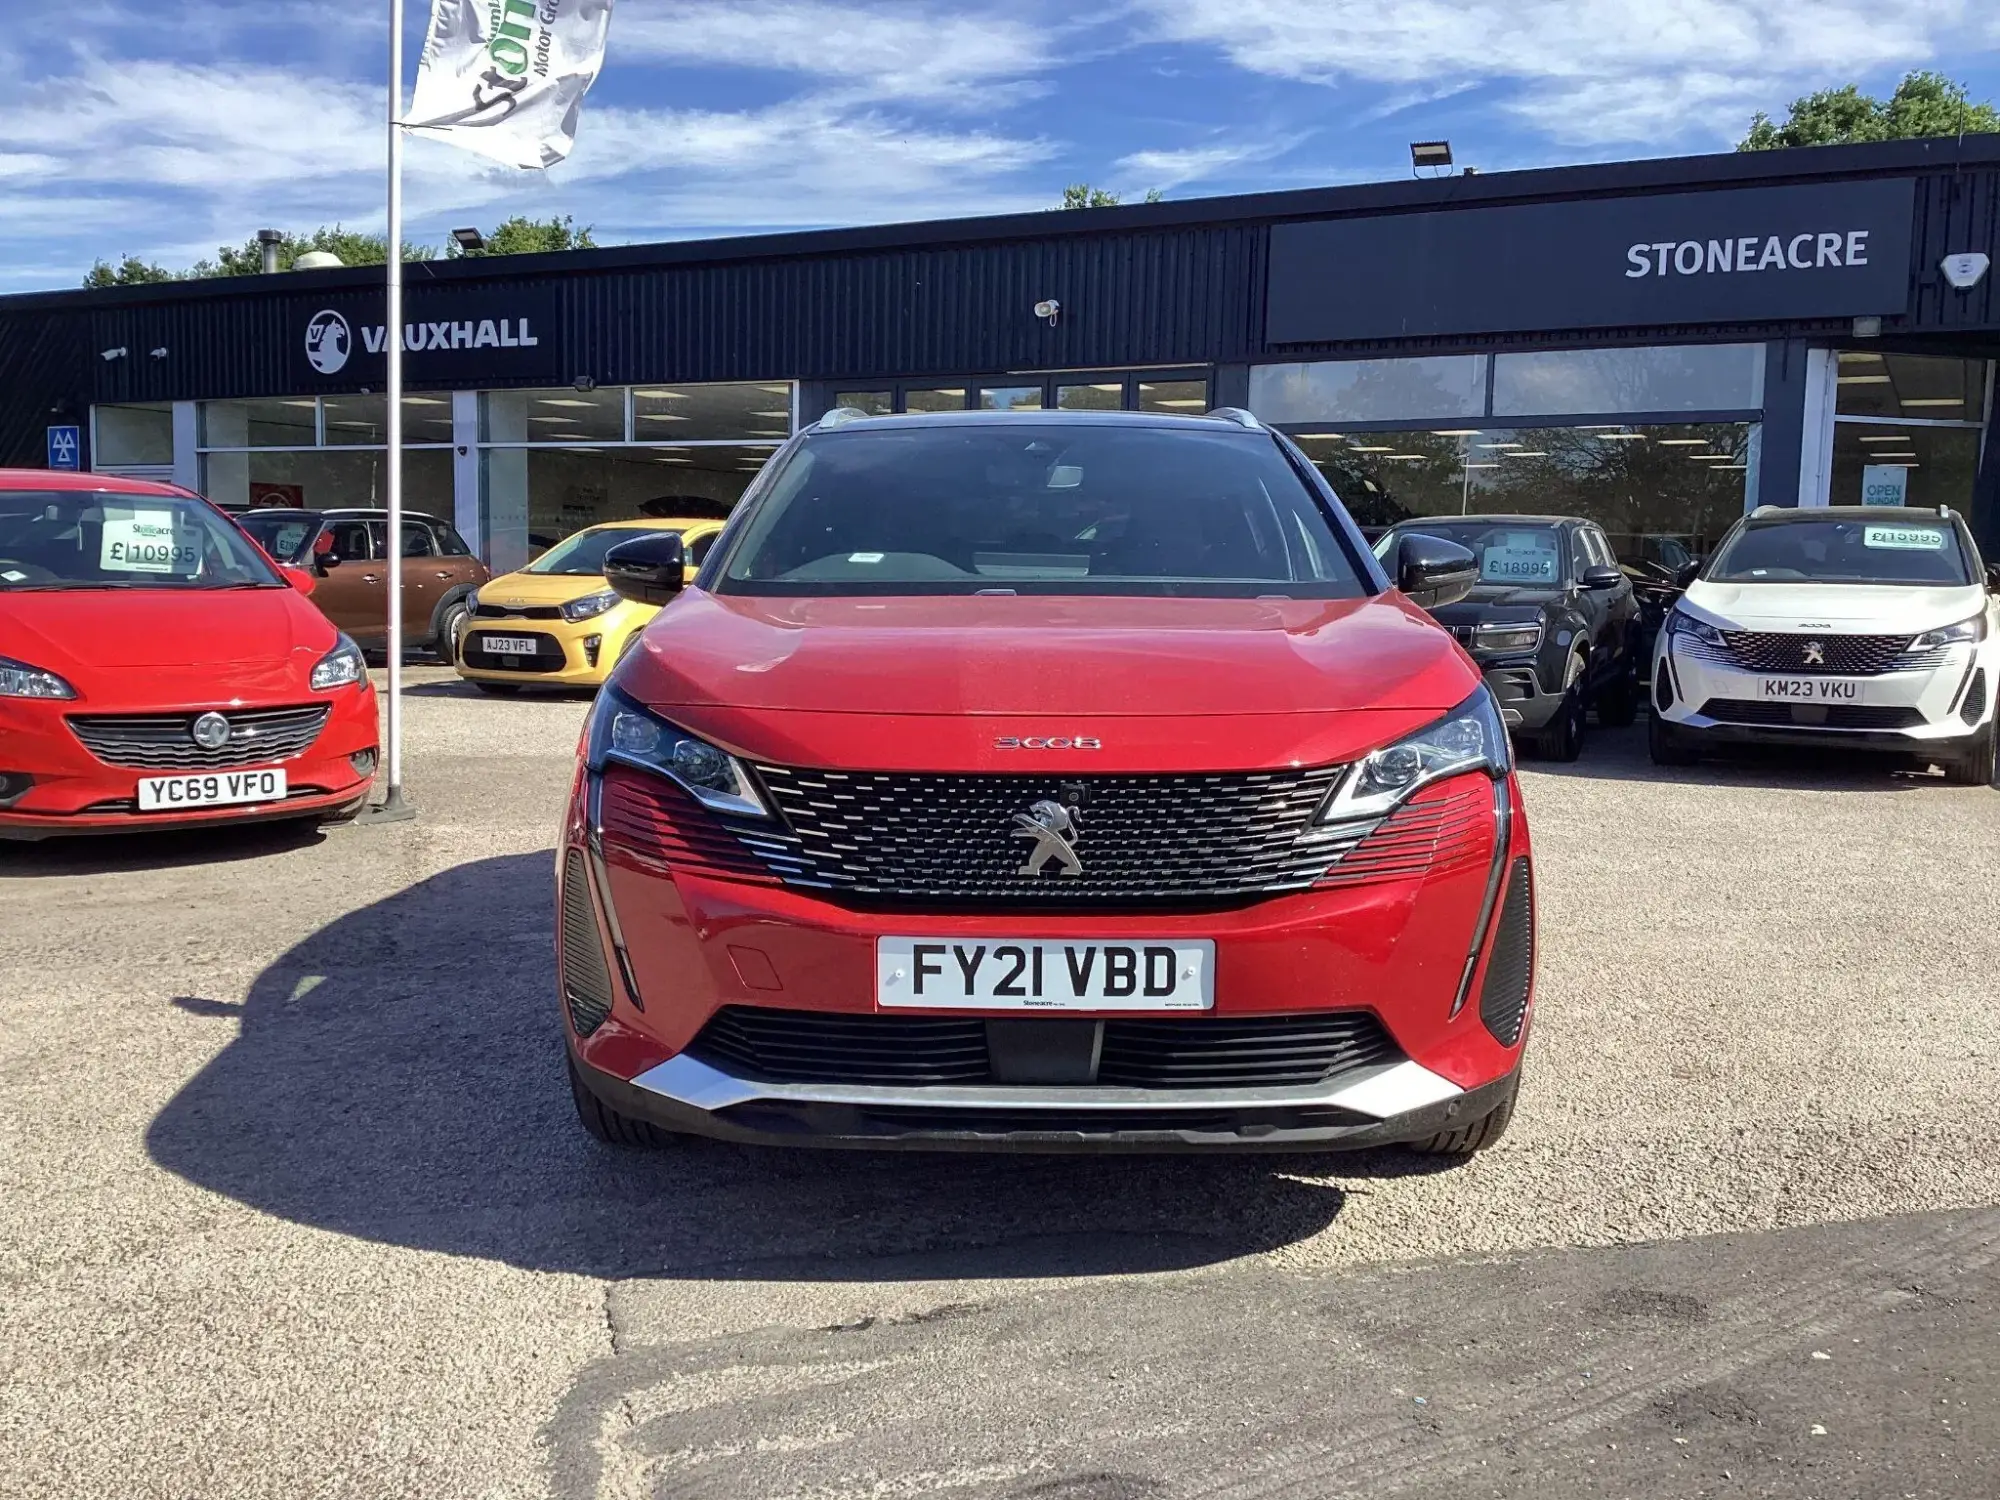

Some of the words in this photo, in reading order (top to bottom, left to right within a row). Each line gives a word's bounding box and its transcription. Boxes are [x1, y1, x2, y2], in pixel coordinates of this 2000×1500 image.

[534, 27, 552, 77] Motor
[1625, 230, 1869, 278] STONEACRE
[361, 318, 538, 353] VUXHALL
[1867, 484, 1901, 496] OPEN
[1866, 496, 1901, 505] SUNDAY
[486, 639, 510, 652] AJ23
[512, 640, 533, 652] VFL
[1764, 679, 1814, 697] KM23
[1819, 681, 1856, 698] VKU
[992, 736, 1102, 750] 3008
[150, 776, 219, 803] YC69
[226, 772, 276, 798] VFO
[913, 944, 1043, 996] FY21
[1064, 946, 1177, 997] VBD
[1023, 999, 1053, 1007] Stoneacre
